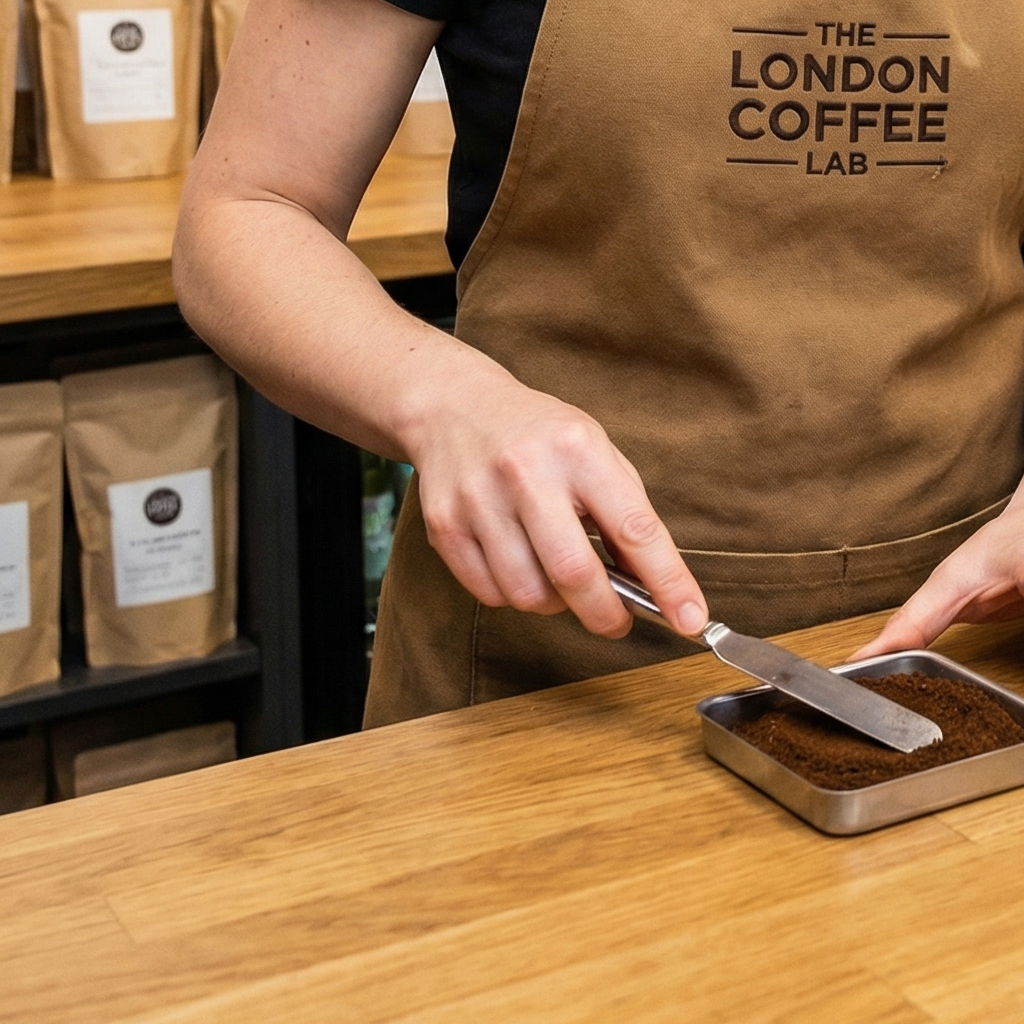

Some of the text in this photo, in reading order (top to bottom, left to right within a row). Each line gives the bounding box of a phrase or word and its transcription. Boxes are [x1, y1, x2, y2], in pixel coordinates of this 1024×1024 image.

[815, 22, 876, 46] THE
[731, 50, 950, 94] LONDON
[728, 97, 949, 143] COFFEE
[806, 151, 869, 176] LAB
